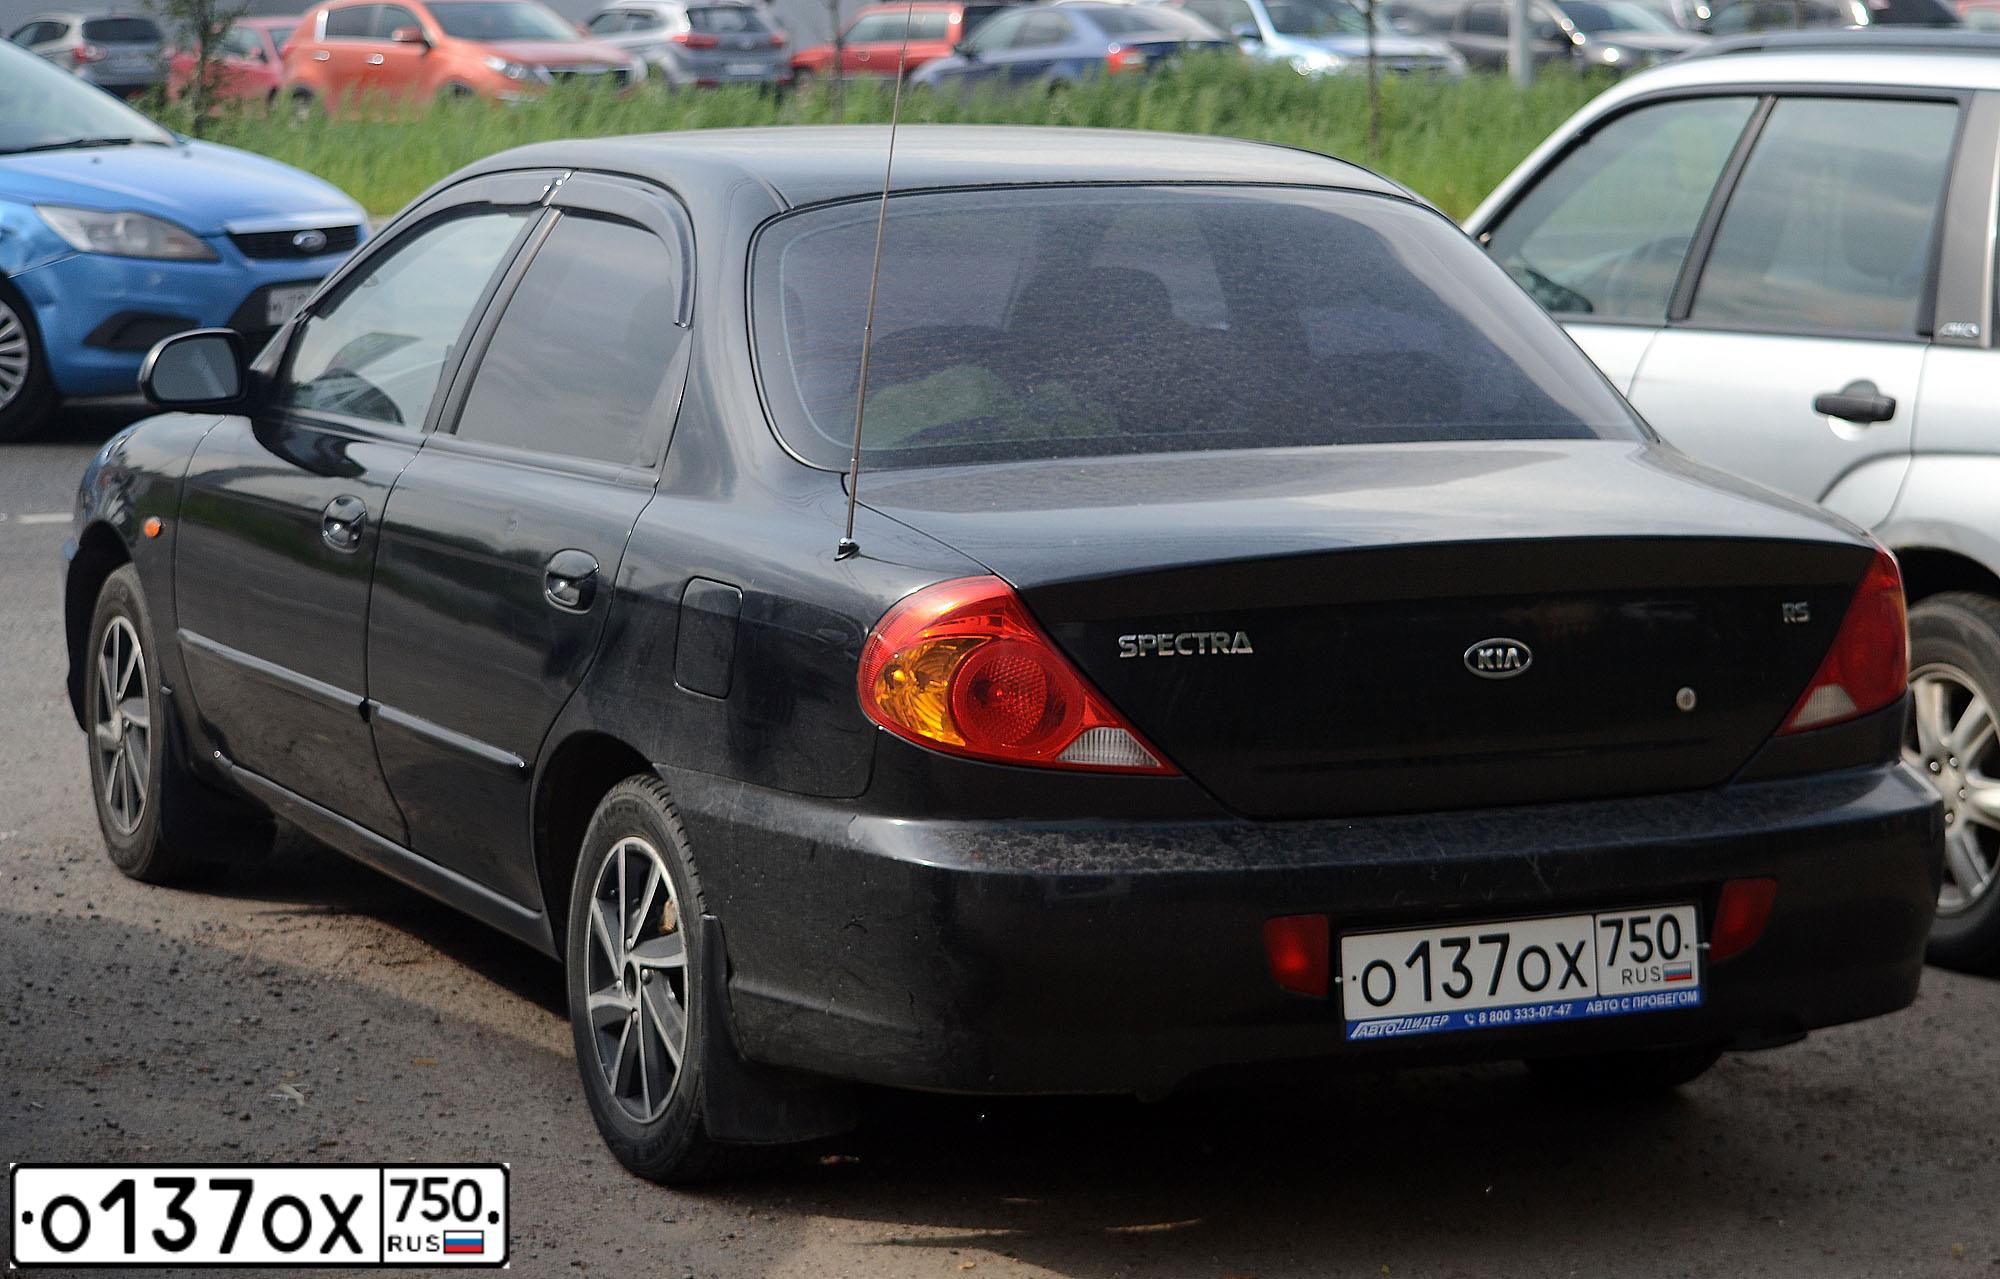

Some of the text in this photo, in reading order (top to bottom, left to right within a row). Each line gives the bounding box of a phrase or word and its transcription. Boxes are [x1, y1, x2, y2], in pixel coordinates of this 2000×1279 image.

[1782, 601, 1809, 623] RS
[1118, 631, 1254, 658] SPECTRA
[1477, 647, 1521, 669] KIA
[1600, 913, 1682, 967] 750
[1621, 966, 1661, 985] RUS
[1585, 998, 1619, 1013] АВТО
[1632, 990, 1698, 1009] ПРОБЕГОМ
[1478, 1003, 1573, 1024] 8 800 333-07-47
